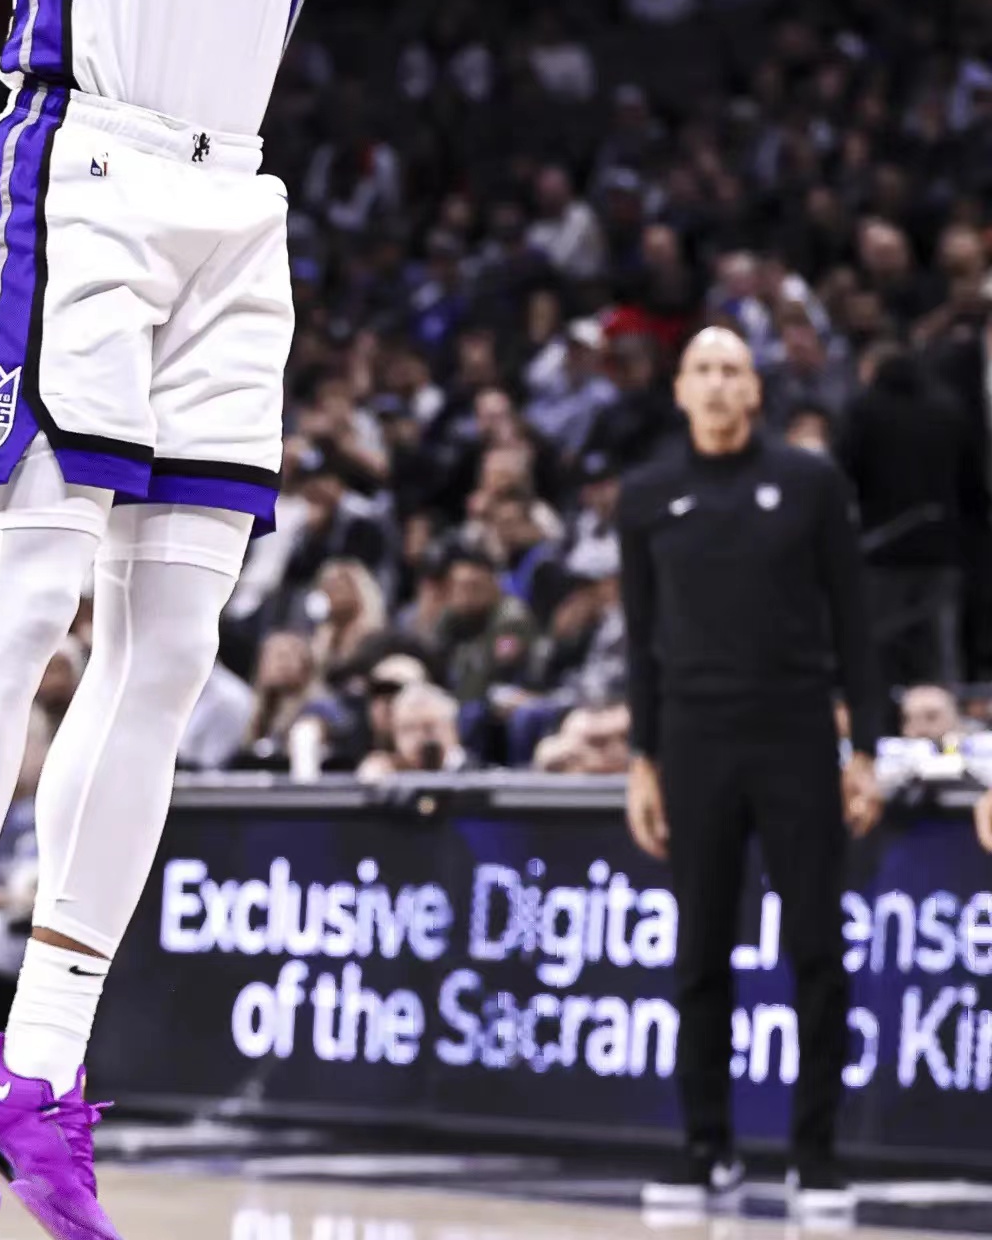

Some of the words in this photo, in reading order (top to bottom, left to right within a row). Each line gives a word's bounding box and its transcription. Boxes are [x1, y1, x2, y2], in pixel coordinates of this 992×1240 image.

[160, 857, 454, 959] Exclusive
[469, 858, 679, 987] Digita
[231, 959, 309, 1059] of
[310, 960, 426, 1066] the
